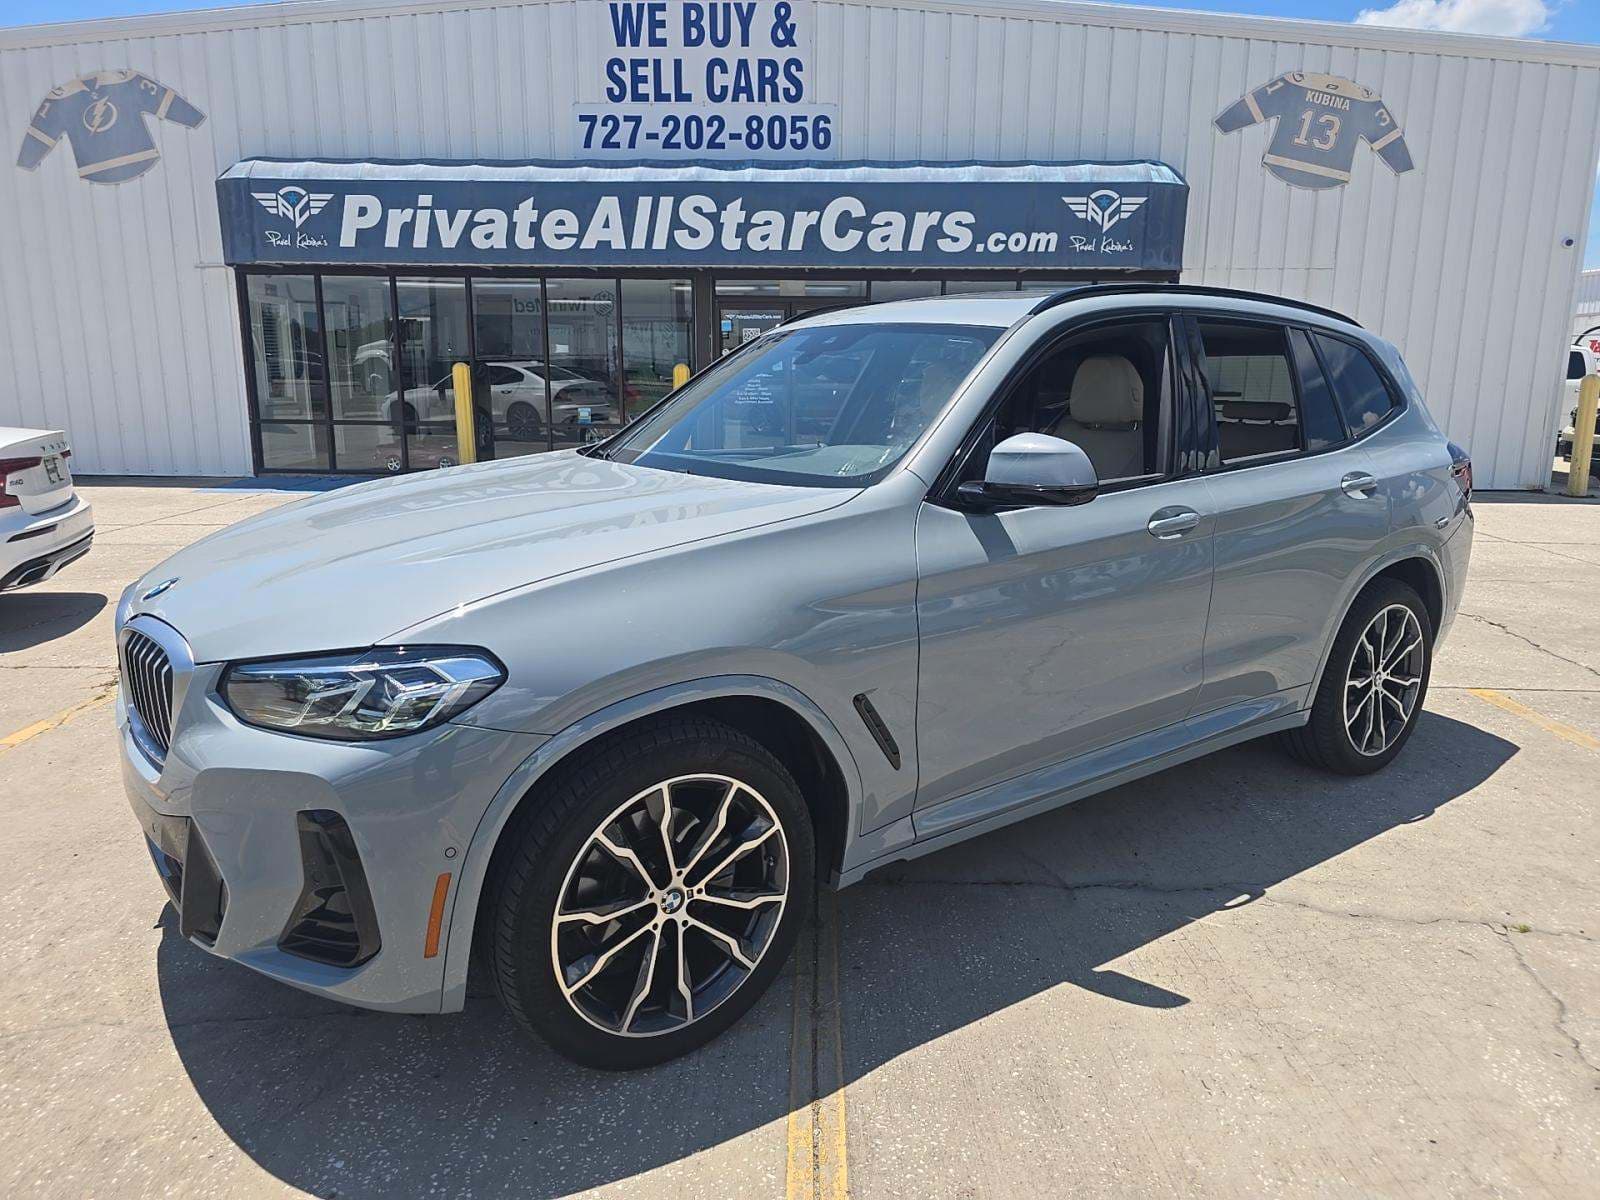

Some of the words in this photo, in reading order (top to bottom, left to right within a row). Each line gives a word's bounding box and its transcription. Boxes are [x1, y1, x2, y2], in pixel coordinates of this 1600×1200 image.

[609, 2, 667, 48] WE
[683, 2, 757, 48] BUY
[770, 1, 798, 48] &
[606, 57, 693, 103] SELL
[705, 57, 804, 103] CARS
[1305, 90, 1351, 112] KUBINA
[578, 114, 832, 150] 727-202-8056
[1292, 108, 1342, 151] 13
[338, 193, 1059, 252] PrivateAllStarCars.com
[1068, 235, 1097, 253] Pavel
[1100, 235, 1135, 255] Kubina's
